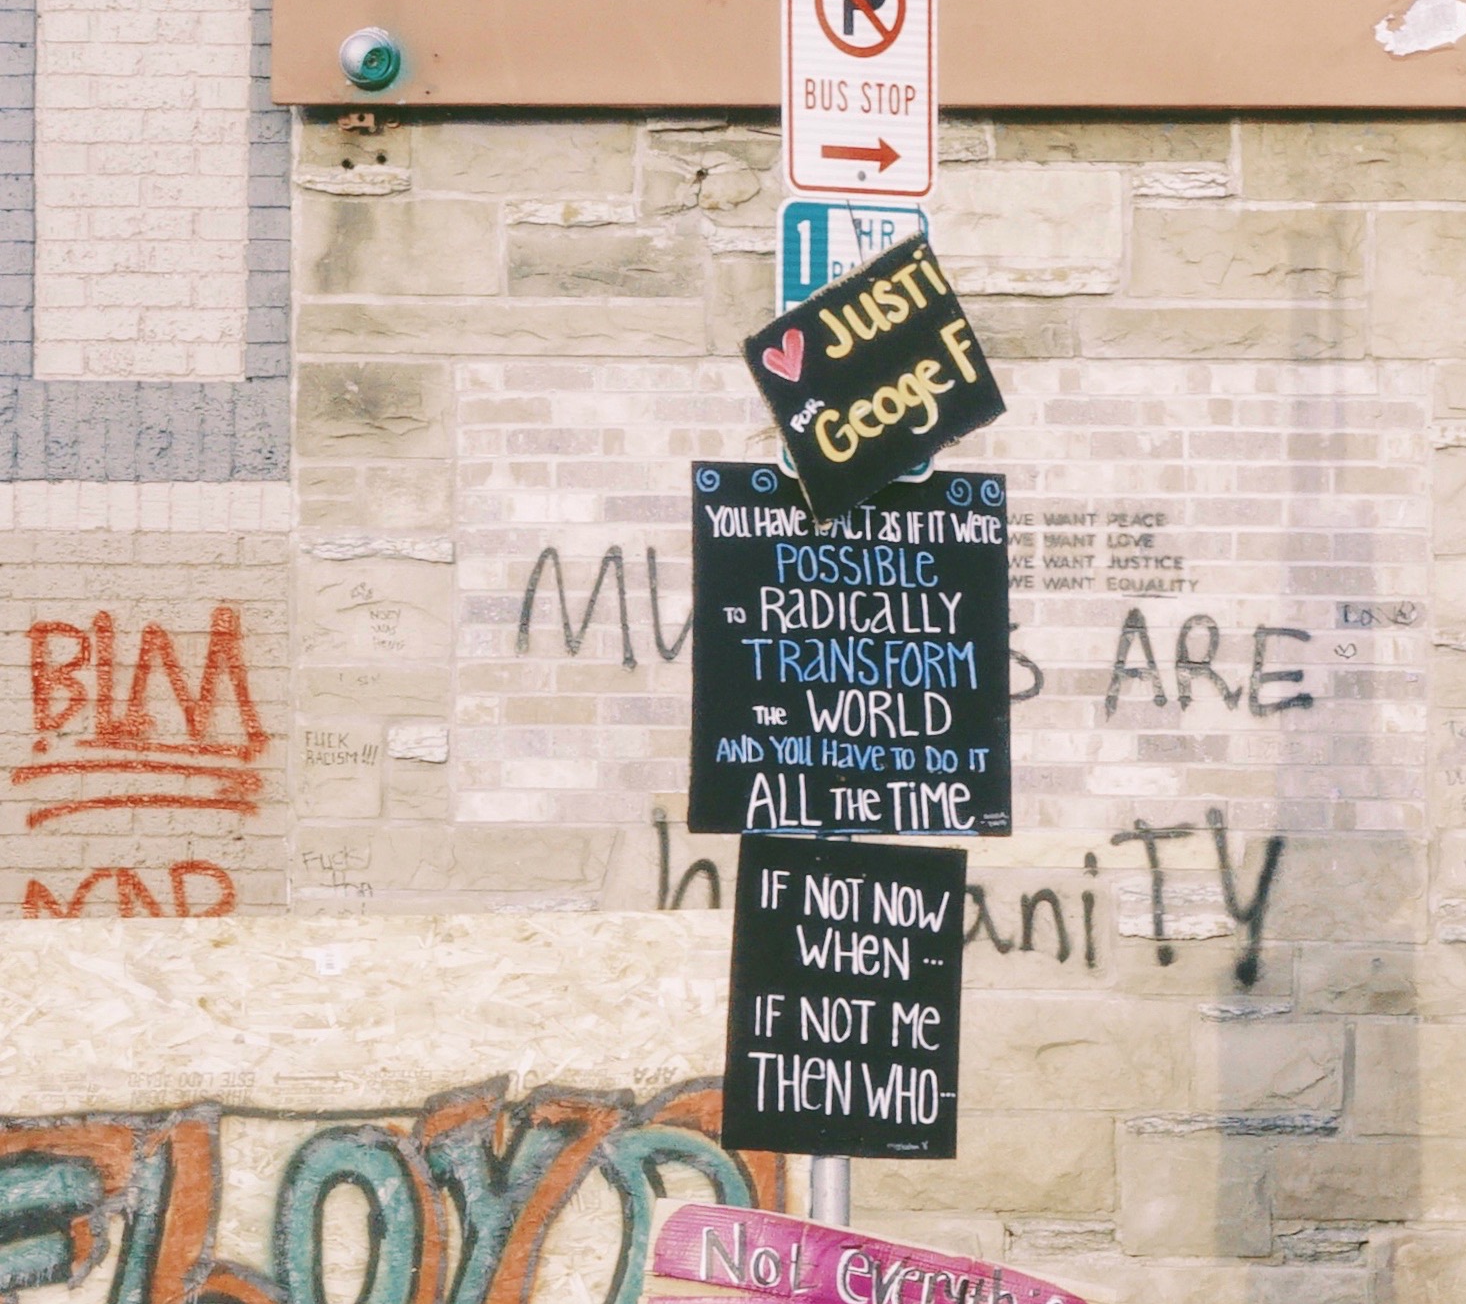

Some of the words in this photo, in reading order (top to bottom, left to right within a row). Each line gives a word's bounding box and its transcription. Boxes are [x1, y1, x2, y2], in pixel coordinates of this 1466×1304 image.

[805, 78, 849, 112] BUS
[861, 81, 916, 116] STOP
[797, 219, 812, 286] 1
[857, 218, 897, 247] HR
[790, 397, 825, 433] FOR
[939, 317, 977, 384] F
[704, 504, 751, 539] YOU
[907, 510, 923, 544] IF
[923, 510, 946, 544] IT
[1007, 512, 1035, 527] WE
[1043, 512, 1097, 527] WANT
[1106, 512, 1167, 528] PEACE
[1007, 532, 1035, 548] WE
[1043, 532, 1097, 548] WANT
[1106, 532, 1155, 549] LOVE
[1007, 554, 1035, 570] WE
[1043, 554, 1097, 570] WANT
[1106, 554, 1185, 571] JUSTICE
[1007, 575, 1035, 592] WE
[1043, 575, 1097, 592] WANT
[1106, 575, 1200, 593] EQUALITY
[26, 605, 269, 761] BLM
[1105, 607, 1314, 719] ARE
[805, 688, 952, 738] WORLD
[304, 730, 350, 748] FUCK
[716, 734, 764, 764] AND
[769, 735, 814, 767] YOU
[889, 746, 916, 772] TO
[925, 745, 959, 773] DO
[968, 747, 990, 774] IT
[746, 772, 823, 829] ALL
[760, 868, 791, 910] IF
[803, 873, 865, 923] NOT
[873, 881, 950, 934] NOW
[754, 994, 786, 1038] IF
[799, 996, 877, 1045] NOT
[700, 1221, 818, 1295] Not
